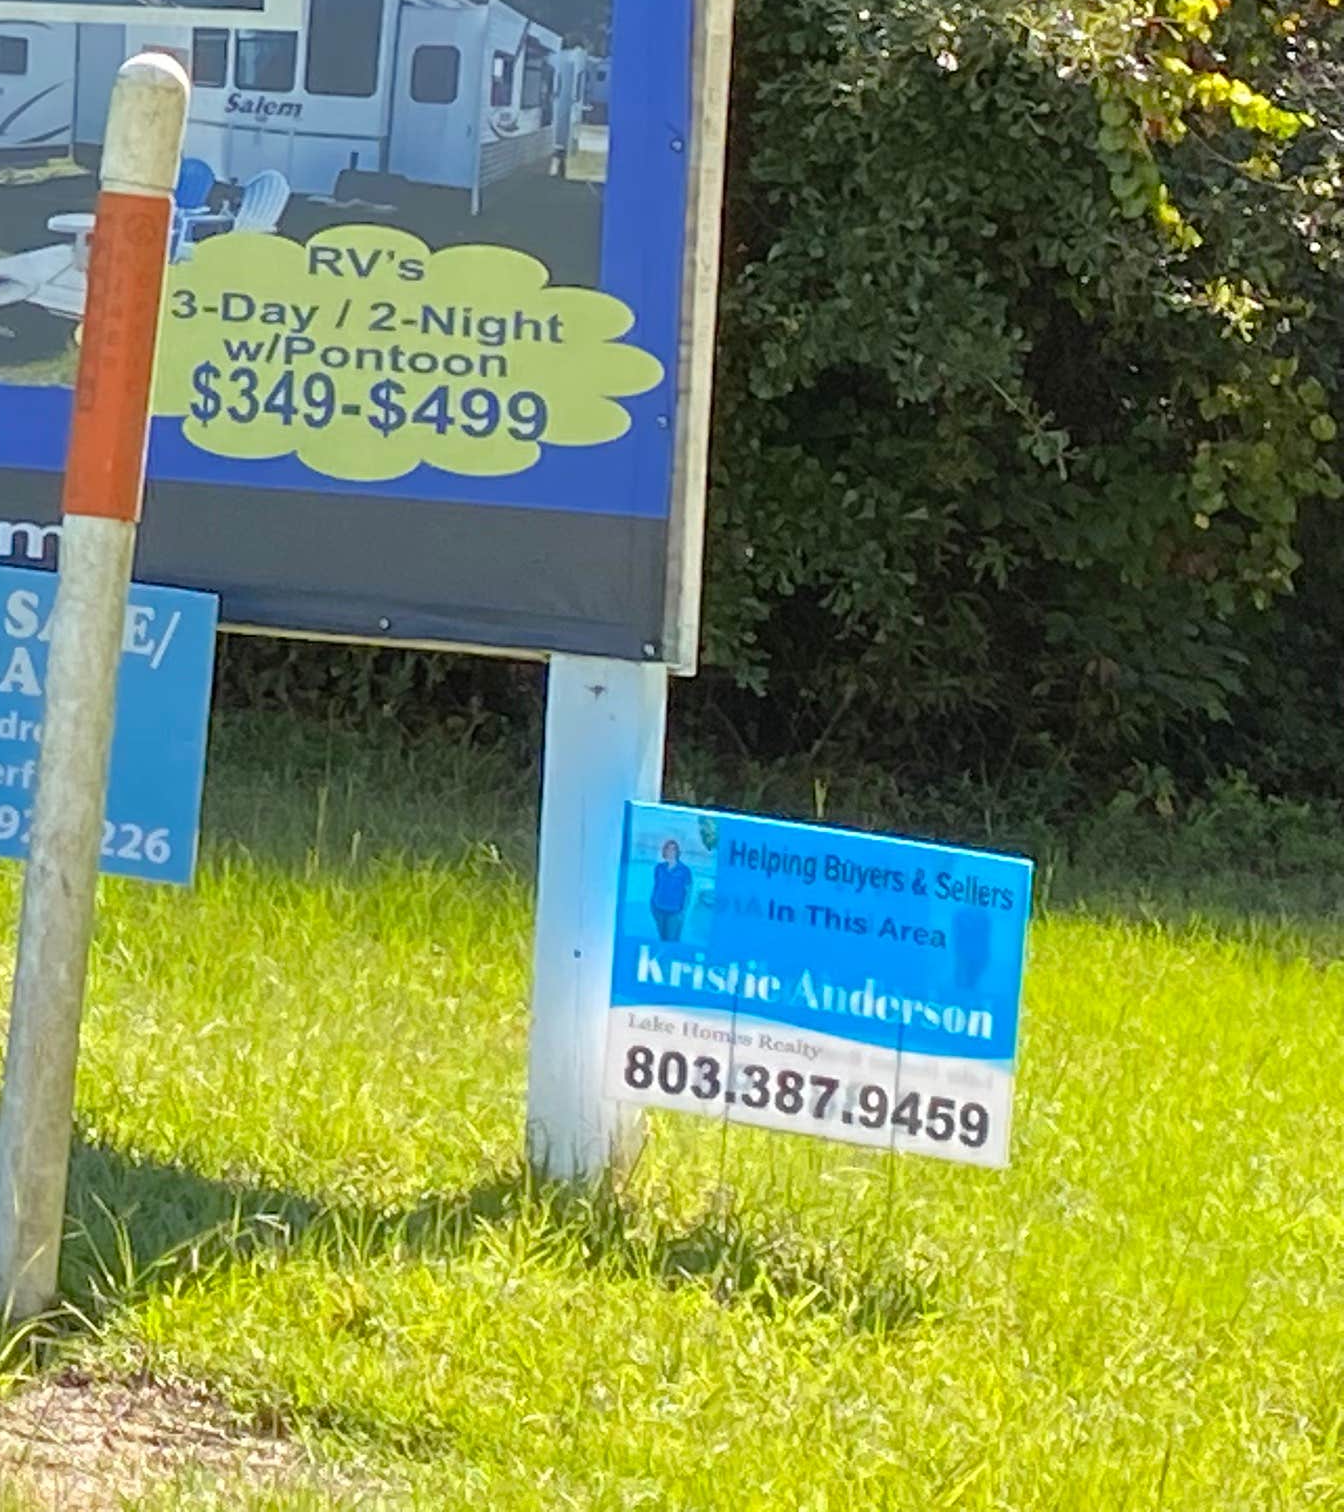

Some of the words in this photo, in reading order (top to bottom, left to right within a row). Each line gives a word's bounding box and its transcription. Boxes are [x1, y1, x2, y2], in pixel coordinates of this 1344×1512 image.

[223, 91, 304, 120] Salem
[308, 245, 425, 283] RV's
[170, 289, 320, 334] 3-Day
[336, 298, 353, 328] /
[368, 302, 565, 348] 2-Night
[222, 334, 509, 378] w/Pontoon
[189, 360, 550, 444] $349-$499
[4, 589, 182, 670] SE/
[729, 838, 818, 886] Helping
[824, 852, 905, 893] Buyers
[910, 869, 930, 897] &
[934, 874, 1015, 912] Sellers
[767, 897, 796, 924] In
[805, 902, 869, 936] This
[877, 915, 948, 950] Area
[636, 943, 782, 1003] Kristie
[788, 967, 994, 1041] Anderson
[626, 1012, 677, 1037] Lake
[682, 1020, 753, 1048] Homes
[757, 1031, 824, 1062] Realty
[623, 1043, 991, 1149] 803.387.9459
